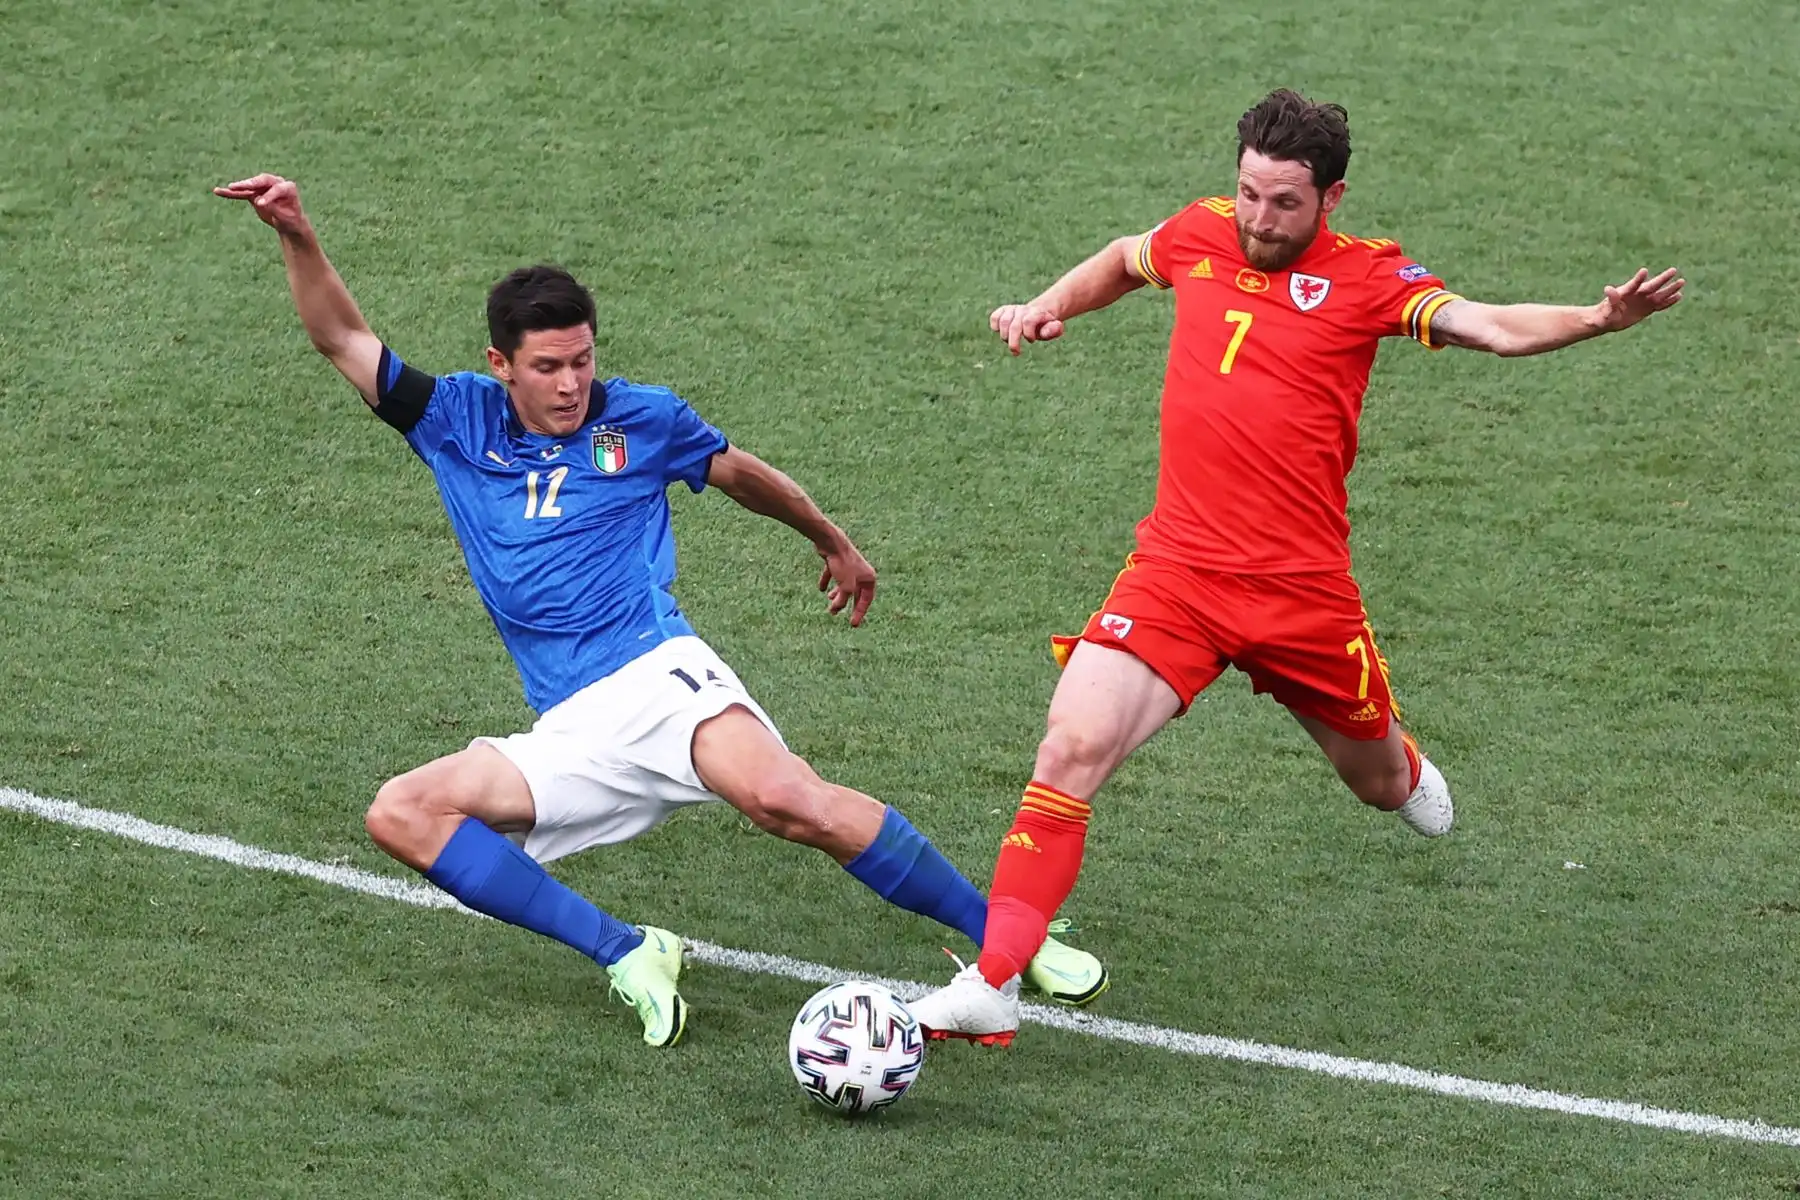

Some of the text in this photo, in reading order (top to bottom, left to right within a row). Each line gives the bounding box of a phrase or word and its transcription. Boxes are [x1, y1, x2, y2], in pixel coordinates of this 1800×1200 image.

[1219, 309, 1254, 375] 7
[594, 435, 623, 444] ITALIA
[523, 466, 569, 520] 12
[1346, 634, 1370, 700] 7
